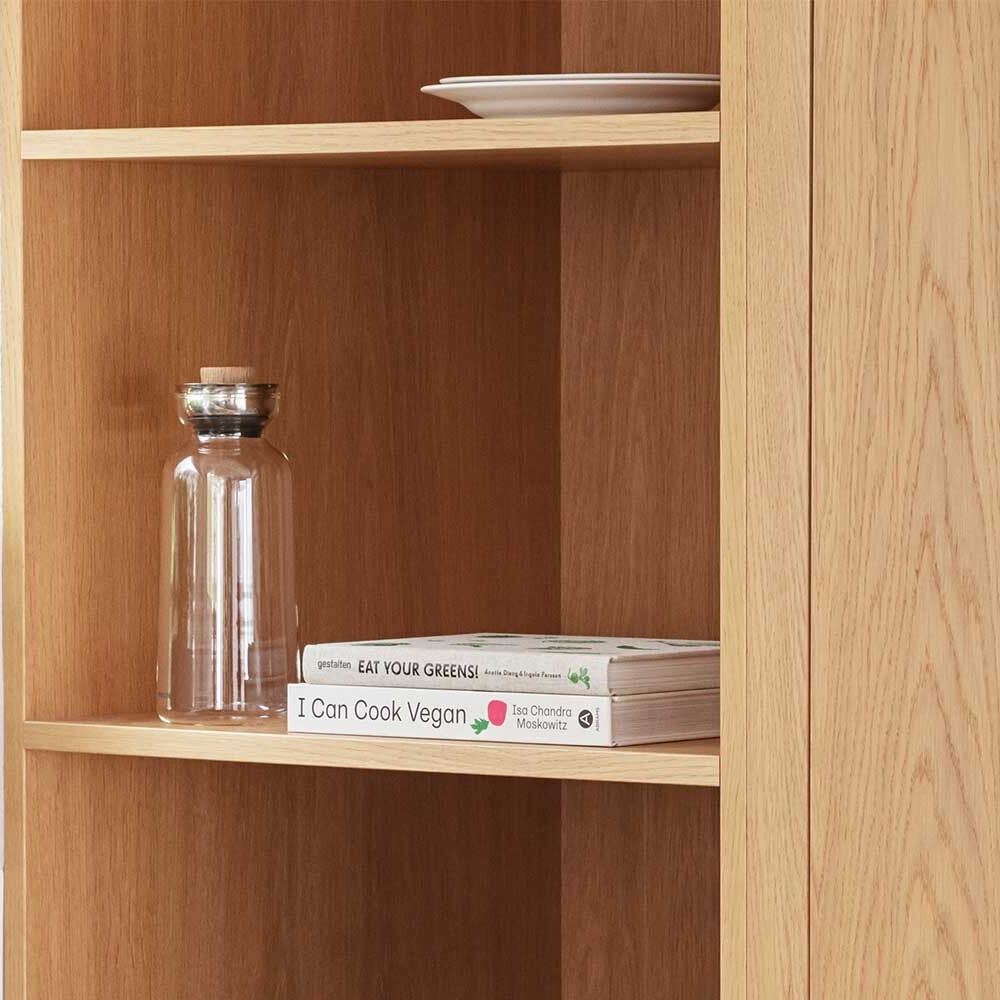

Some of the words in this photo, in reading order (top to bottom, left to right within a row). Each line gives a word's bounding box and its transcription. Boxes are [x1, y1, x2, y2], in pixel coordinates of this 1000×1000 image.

[358, 660, 380, 674] EAT
[384, 661, 420, 676] YOUR
[424, 662, 479, 679] GREENS!
[298, 697, 306, 718] I
[311, 698, 348, 720] Can
[354, 699, 402, 722] Cook
[407, 701, 467, 729] Vegan
[512, 704, 529, 717] Isa
[530, 705, 572, 718] Chandra
[516, 717, 568, 731] Moskowitz
